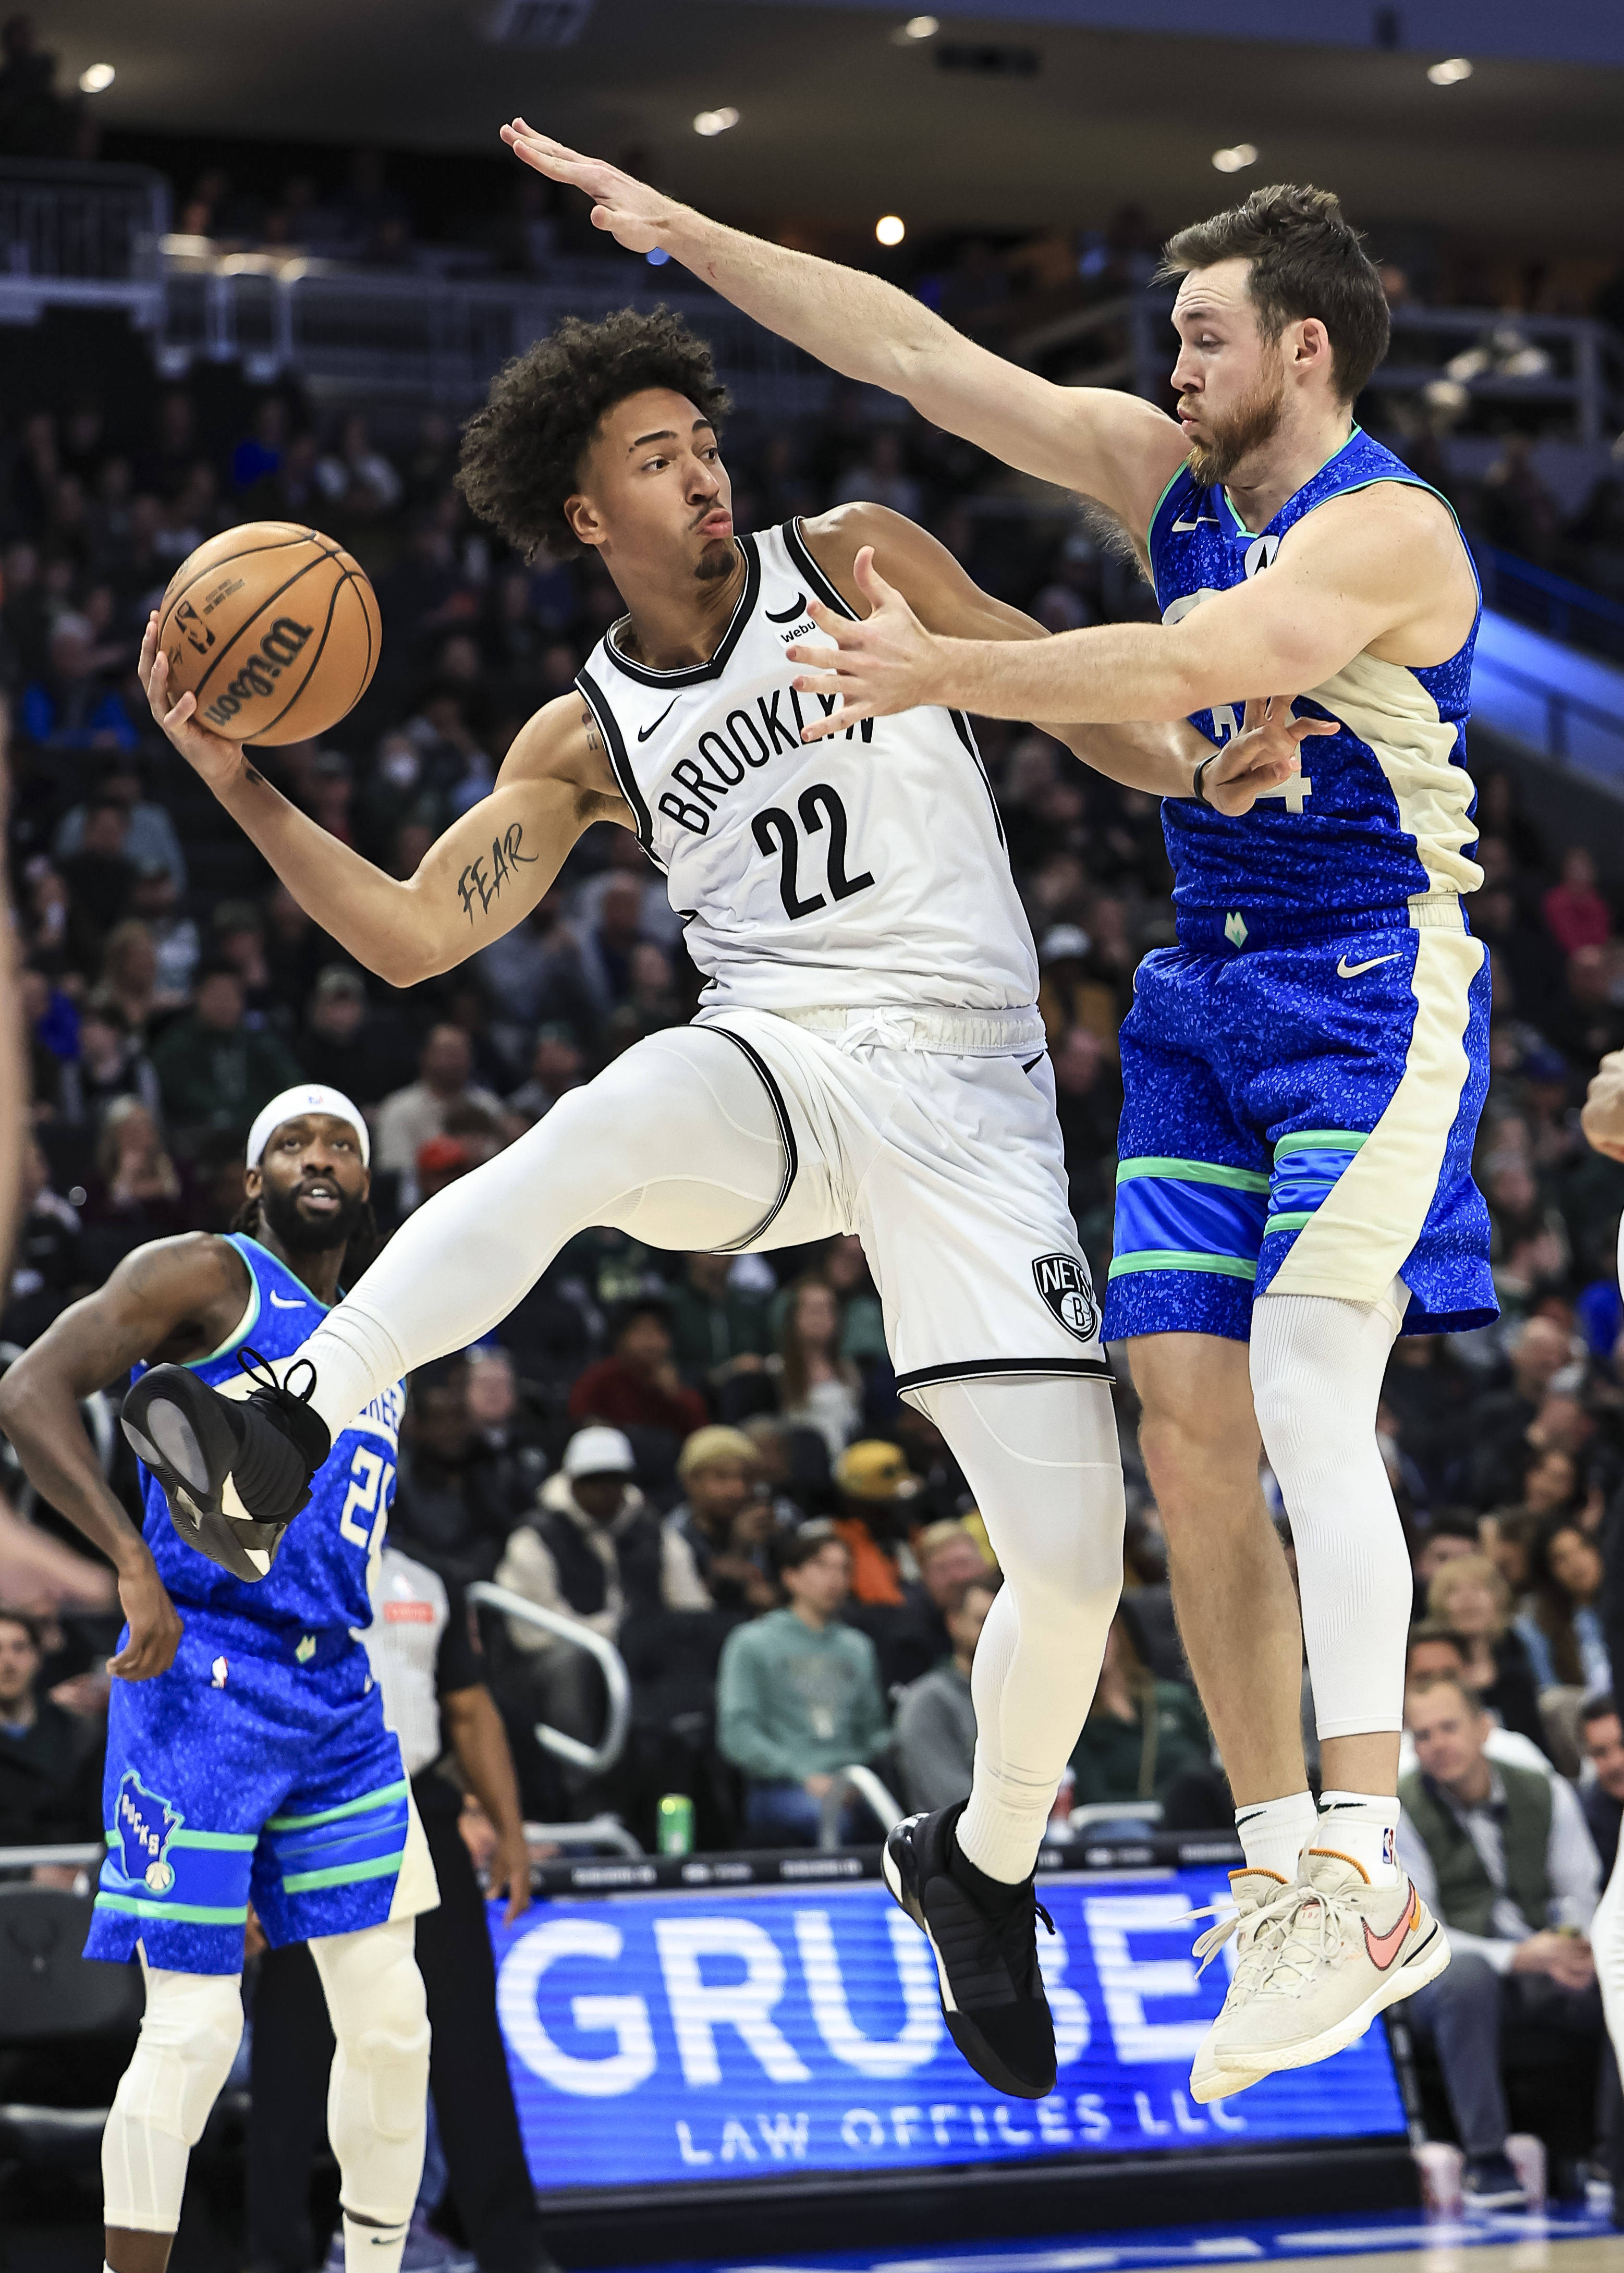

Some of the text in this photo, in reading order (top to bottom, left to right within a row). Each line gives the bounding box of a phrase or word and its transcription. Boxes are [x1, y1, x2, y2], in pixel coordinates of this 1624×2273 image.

[204, 617, 314, 726] Wilson
[458, 822, 539, 927] FEAR
[751, 783, 875, 921] 22
[1042, 1259, 1091, 1303] NETS
[1072, 1297, 1085, 1326] B
[676, 2088, 1249, 2166] LAW OFFICES LLC
